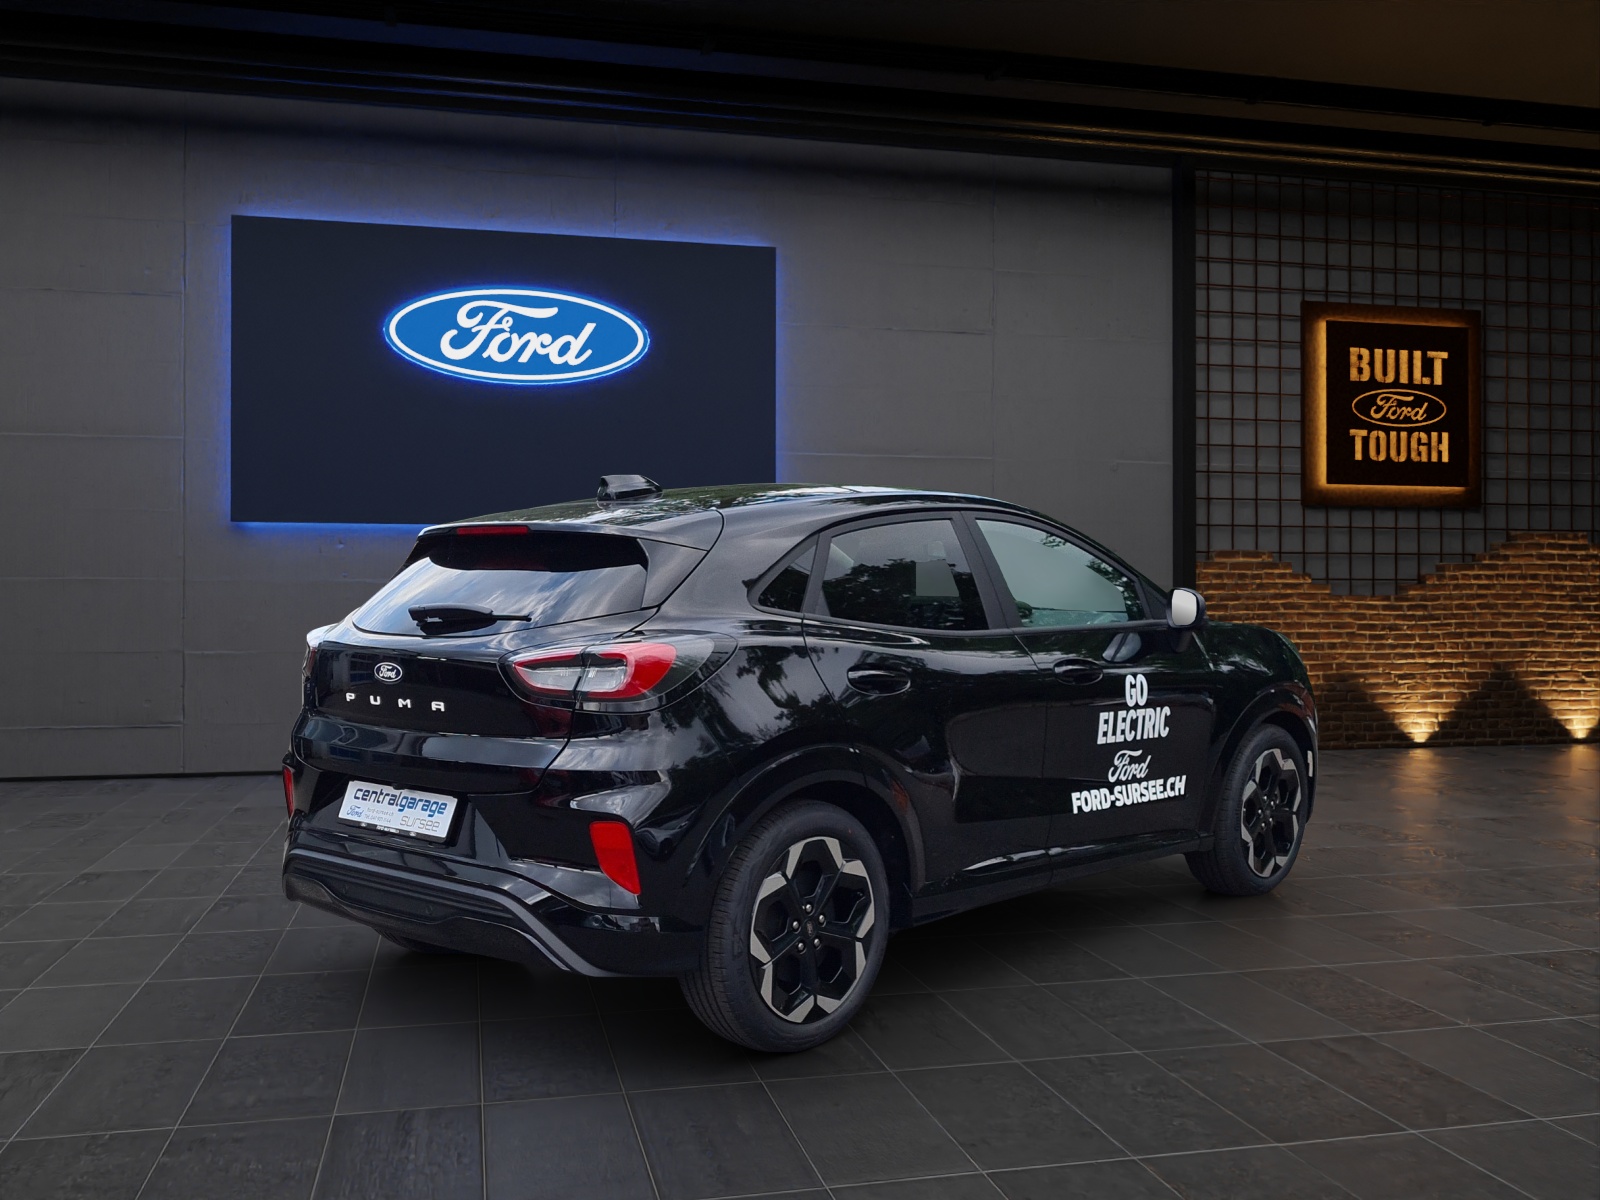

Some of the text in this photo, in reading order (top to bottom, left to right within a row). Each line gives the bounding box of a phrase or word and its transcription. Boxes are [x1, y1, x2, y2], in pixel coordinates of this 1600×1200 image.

[440, 300, 597, 366] Ford
[1349, 346, 1449, 386] BUILT
[1370, 393, 1429, 421] Ford
[1349, 428, 1449, 463] TOUGH
[1125, 673, 1149, 707] GO
[1097, 706, 1171, 745] ELECTRIC
[1108, 749, 1152, 783] Ford
[346, 804, 365, 818] Ford
[353, 788, 448, 818] centralgarage
[1071, 774, 1187, 814] FORD-SURSEE.CH
[399, 815, 441, 833] sursee
